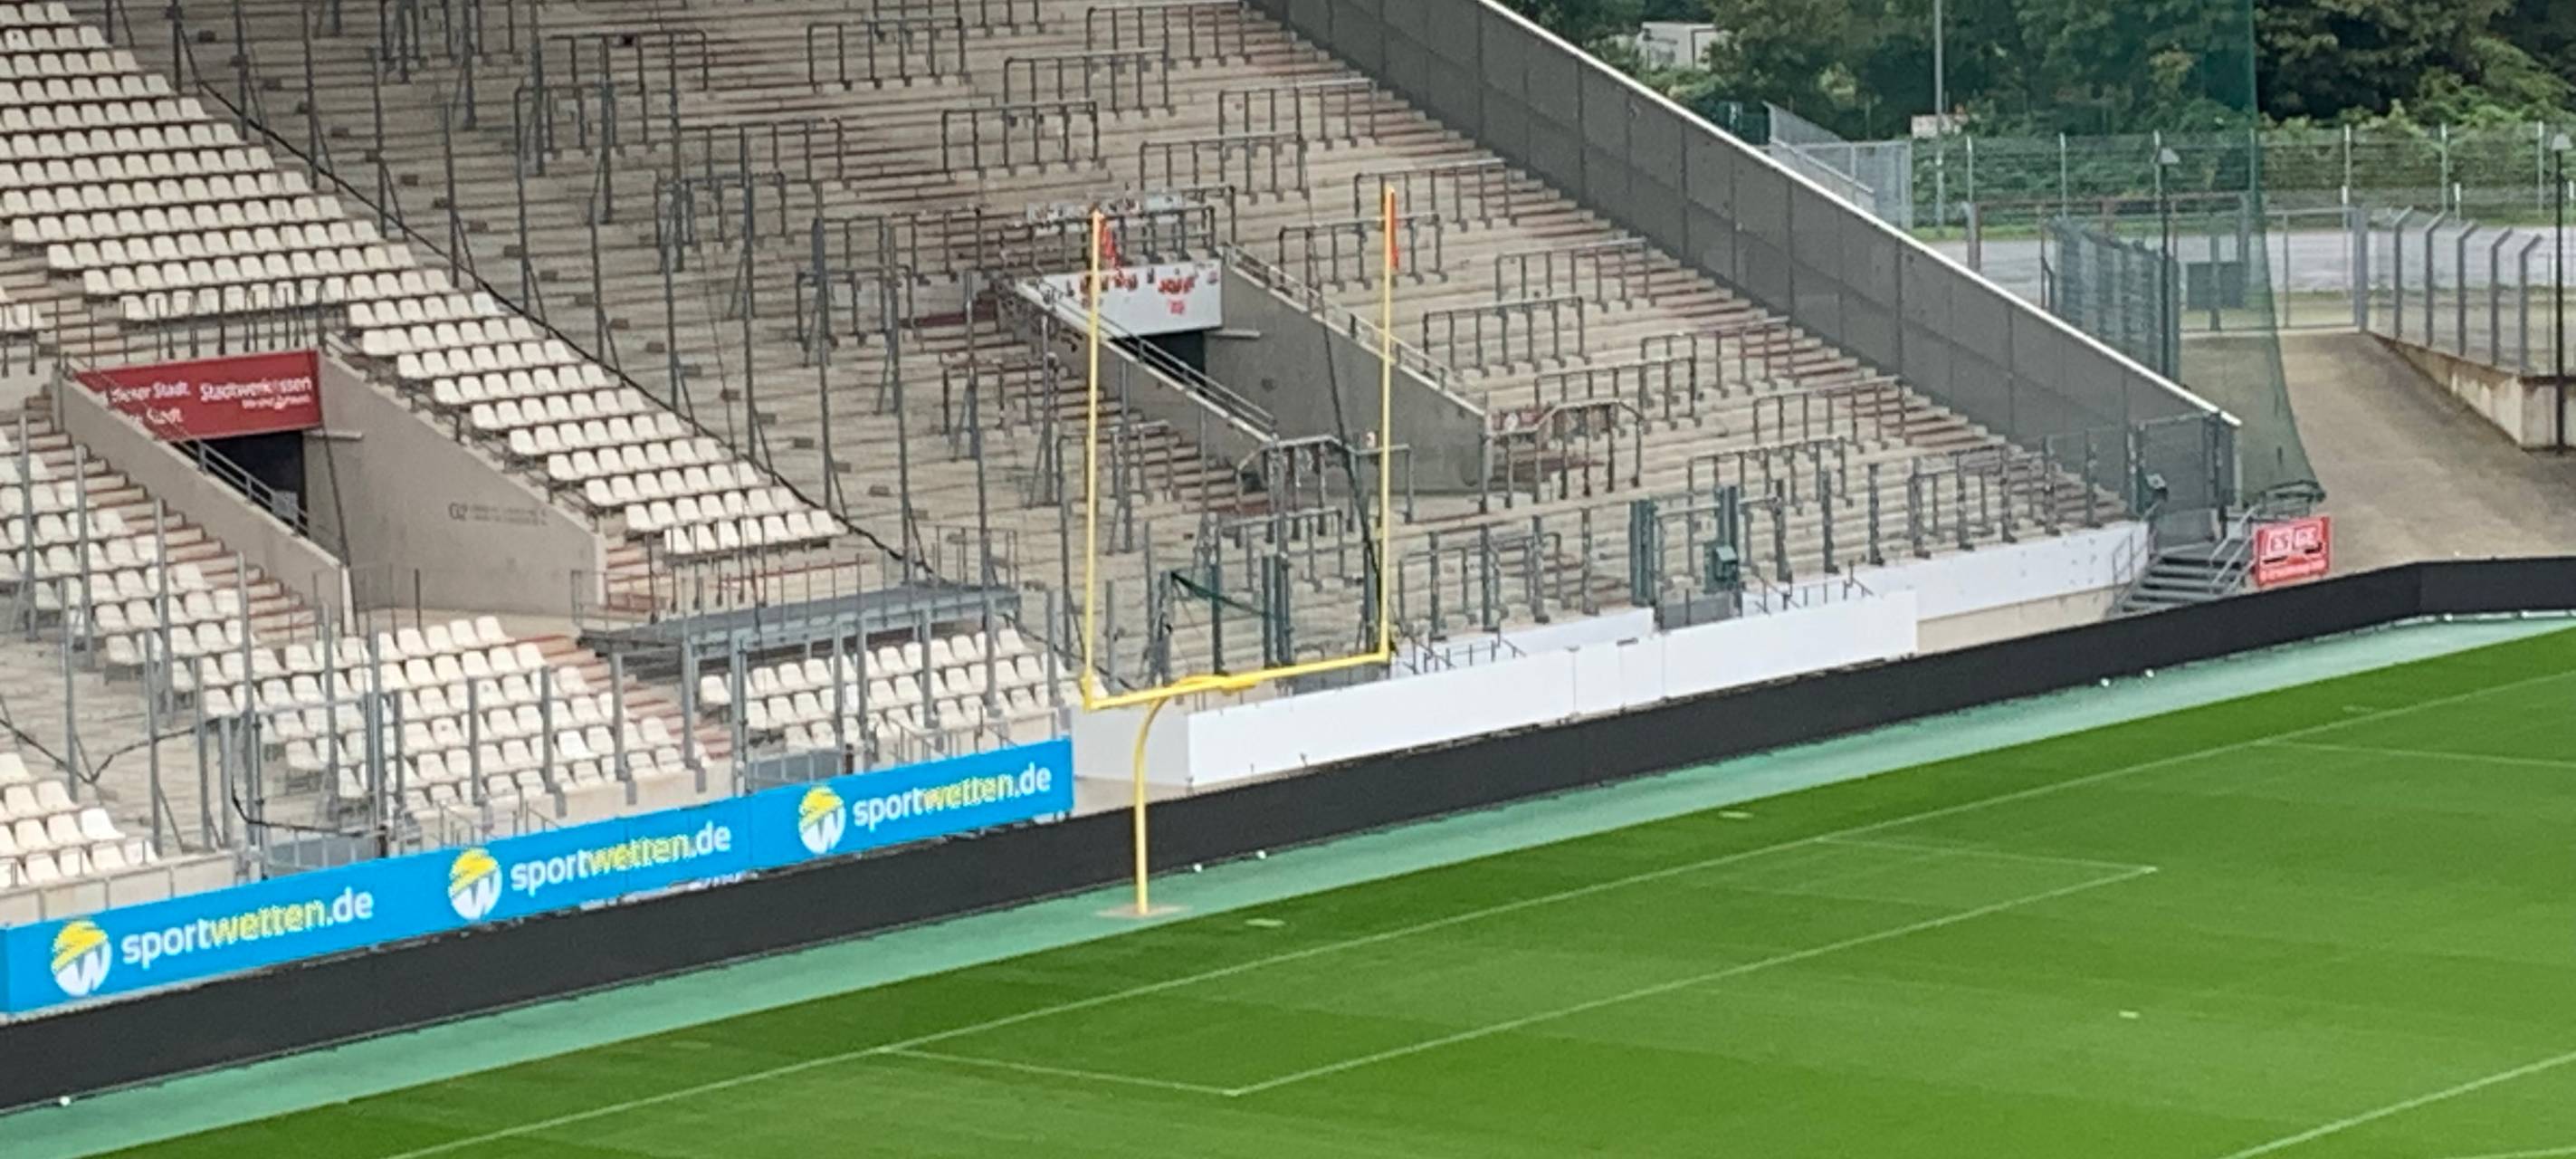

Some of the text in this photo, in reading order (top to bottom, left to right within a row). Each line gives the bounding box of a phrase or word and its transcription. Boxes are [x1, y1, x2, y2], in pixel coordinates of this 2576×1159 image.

[853, 761, 1052, 832] sportwetten.de
[510, 820, 731, 896] sportwetten.de
[121, 886, 375, 970] sportwetten.de
